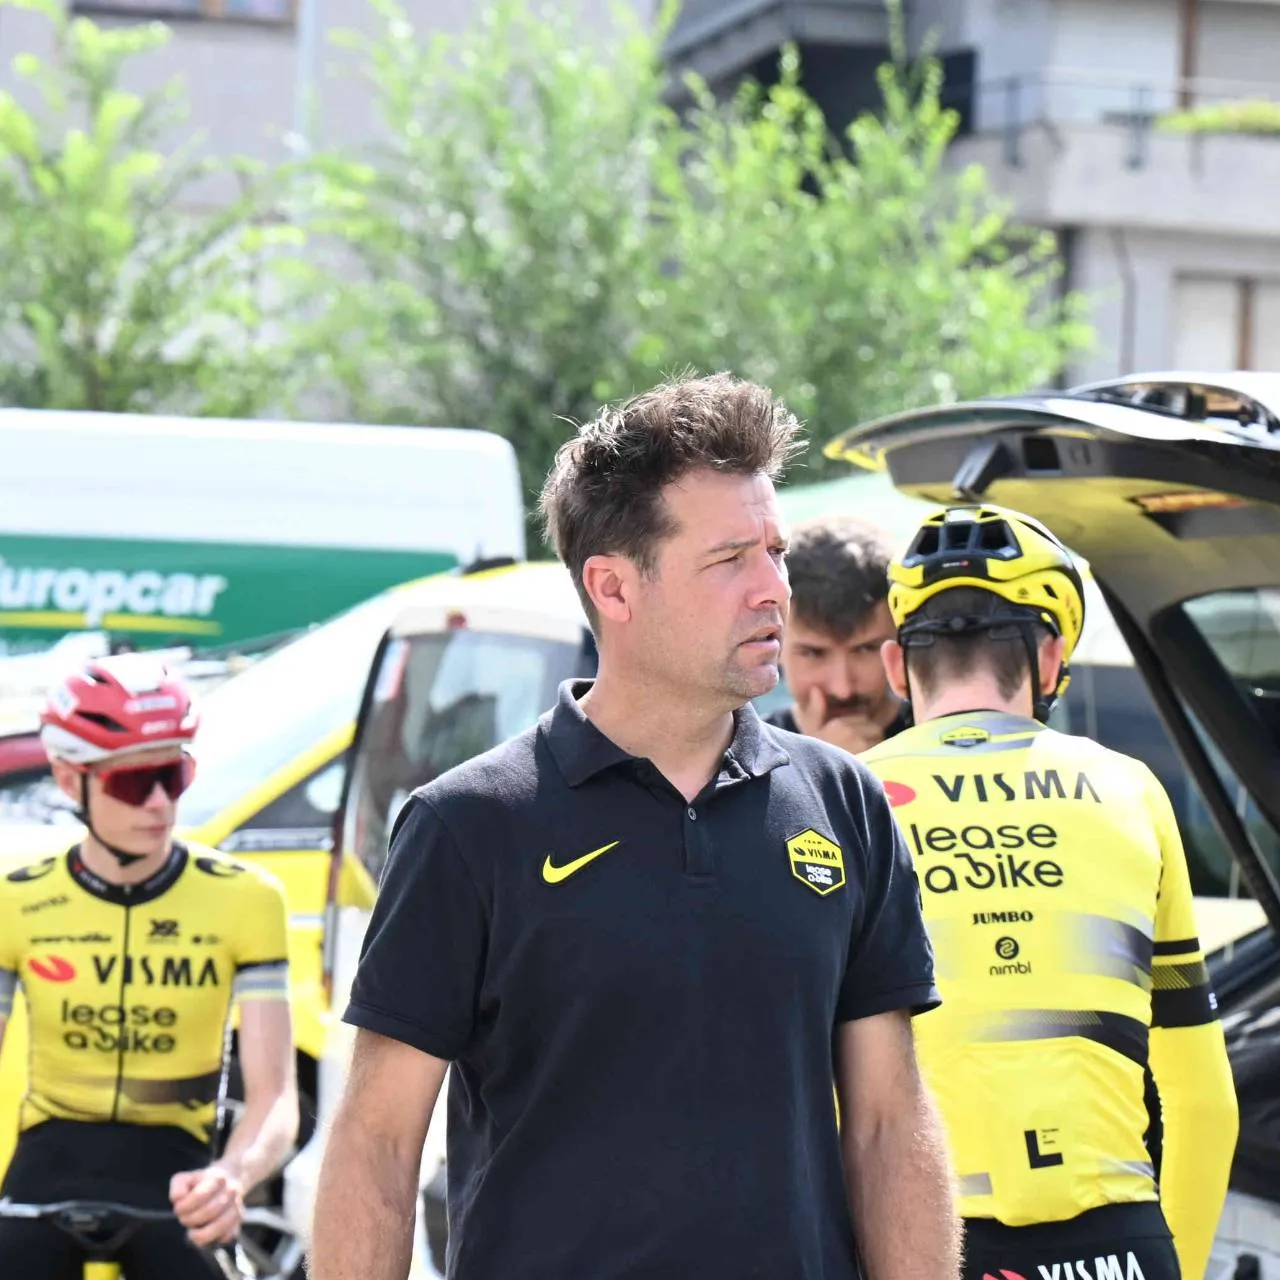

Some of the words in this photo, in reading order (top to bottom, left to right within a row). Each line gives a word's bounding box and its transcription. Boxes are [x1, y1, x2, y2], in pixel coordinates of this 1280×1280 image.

[931, 769, 1103, 803] VISMA
[910, 823, 1058, 856] lease
[808, 848, 837, 860] VISMA
[972, 911, 1034, 925] JUMBO
[92, 955, 219, 987] VISMA
[989, 961, 1032, 977] nimbl
[61, 999, 178, 1027] lease
